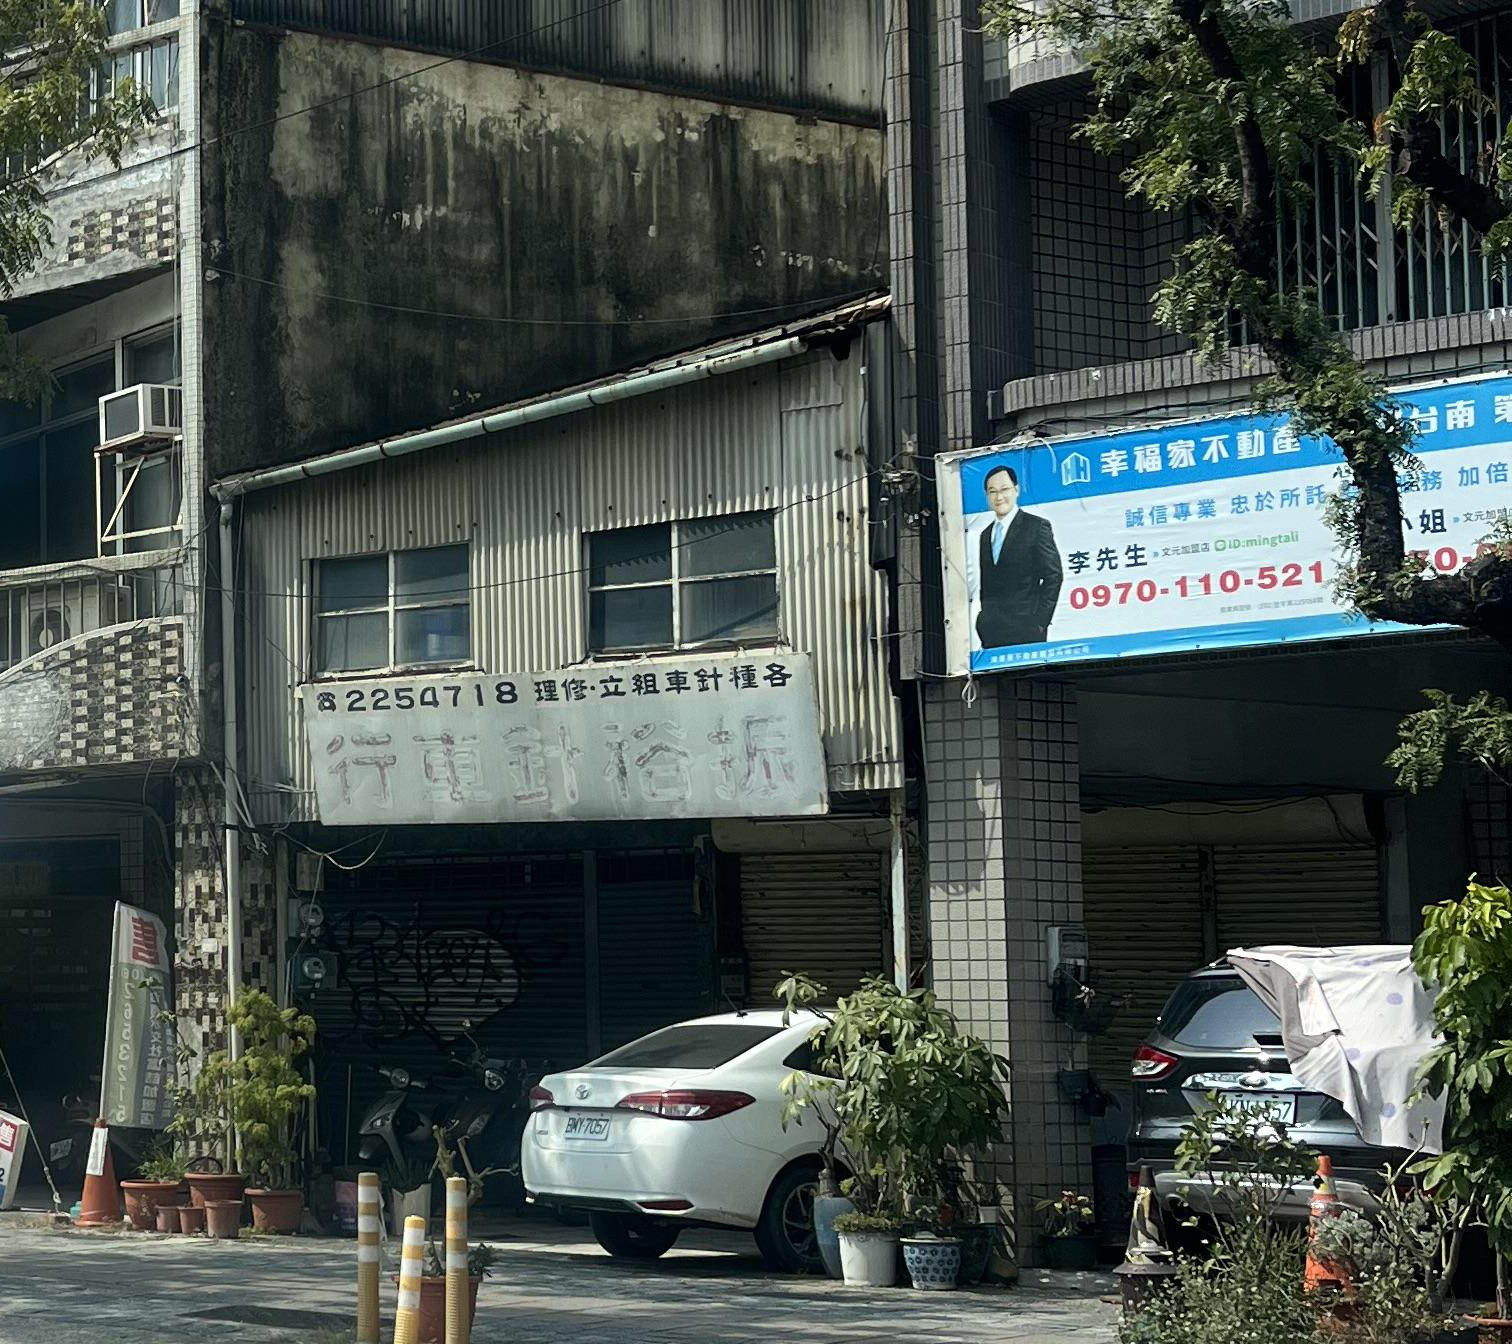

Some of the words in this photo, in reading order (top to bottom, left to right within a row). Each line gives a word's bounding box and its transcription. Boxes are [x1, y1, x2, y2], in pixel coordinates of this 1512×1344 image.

[1099, 427, 1301, 478] 幸福家不動產
[1124, 497, 1218, 529] 誠信專業
[1230, 483, 1327, 515] 忠於所託
[1067, 543, 1149, 574] 李先生
[1069, 560, 1324, 610] 0970-110-521
[347, 682, 518, 712] 2254718
